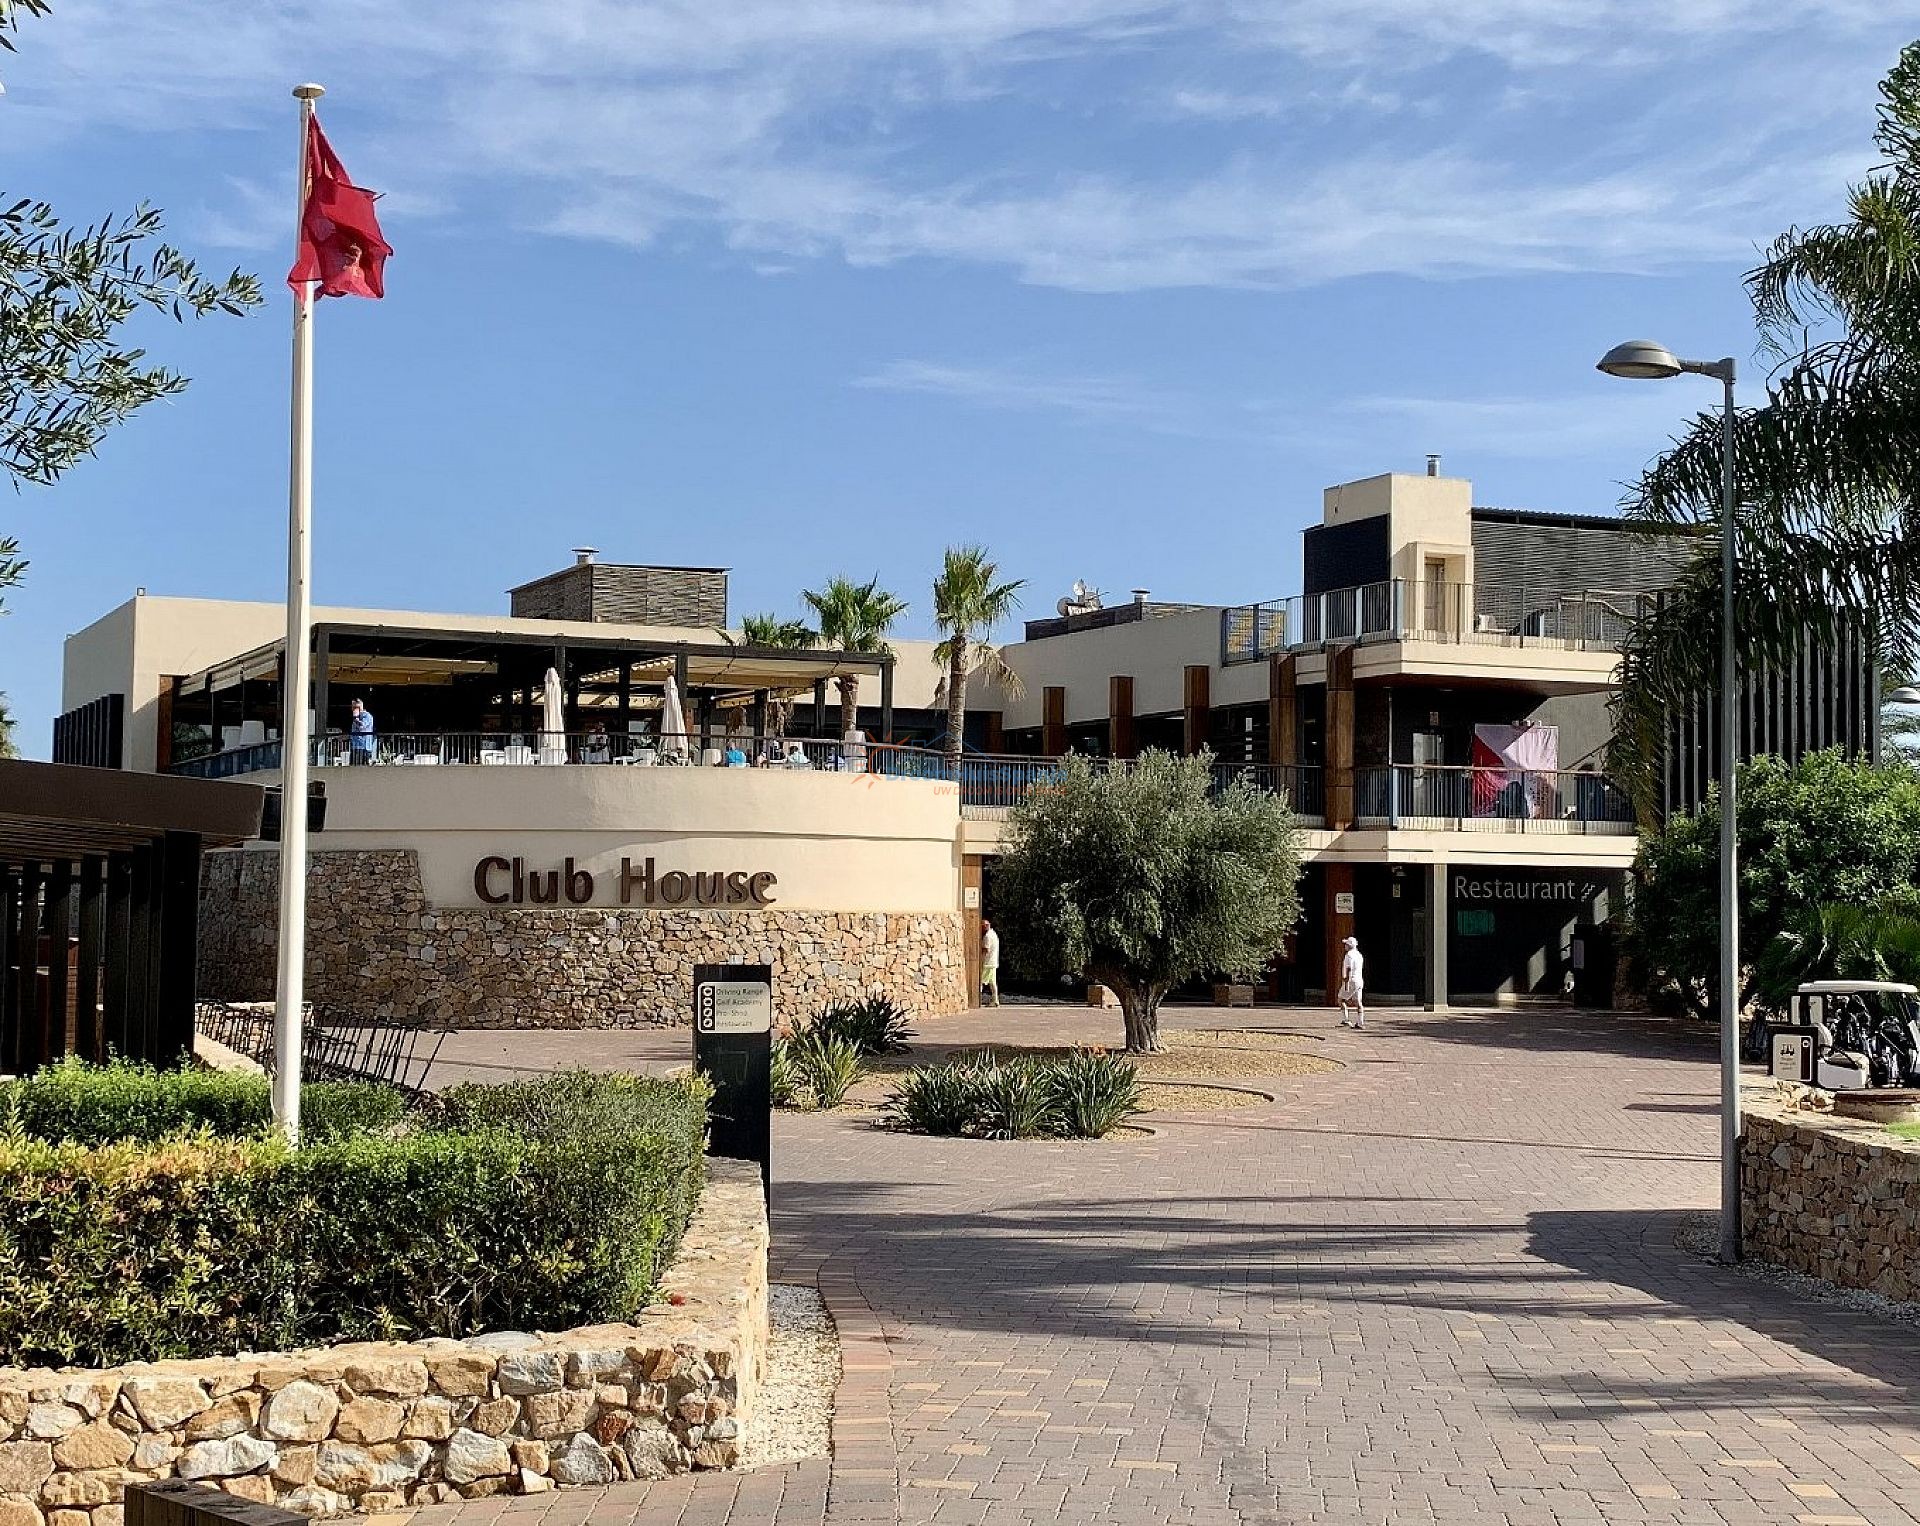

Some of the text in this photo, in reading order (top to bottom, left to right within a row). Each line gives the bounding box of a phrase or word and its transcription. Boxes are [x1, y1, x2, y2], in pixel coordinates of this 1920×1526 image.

[473, 855, 778, 904] Club House
[1454, 875, 1576, 900] Restaurant
